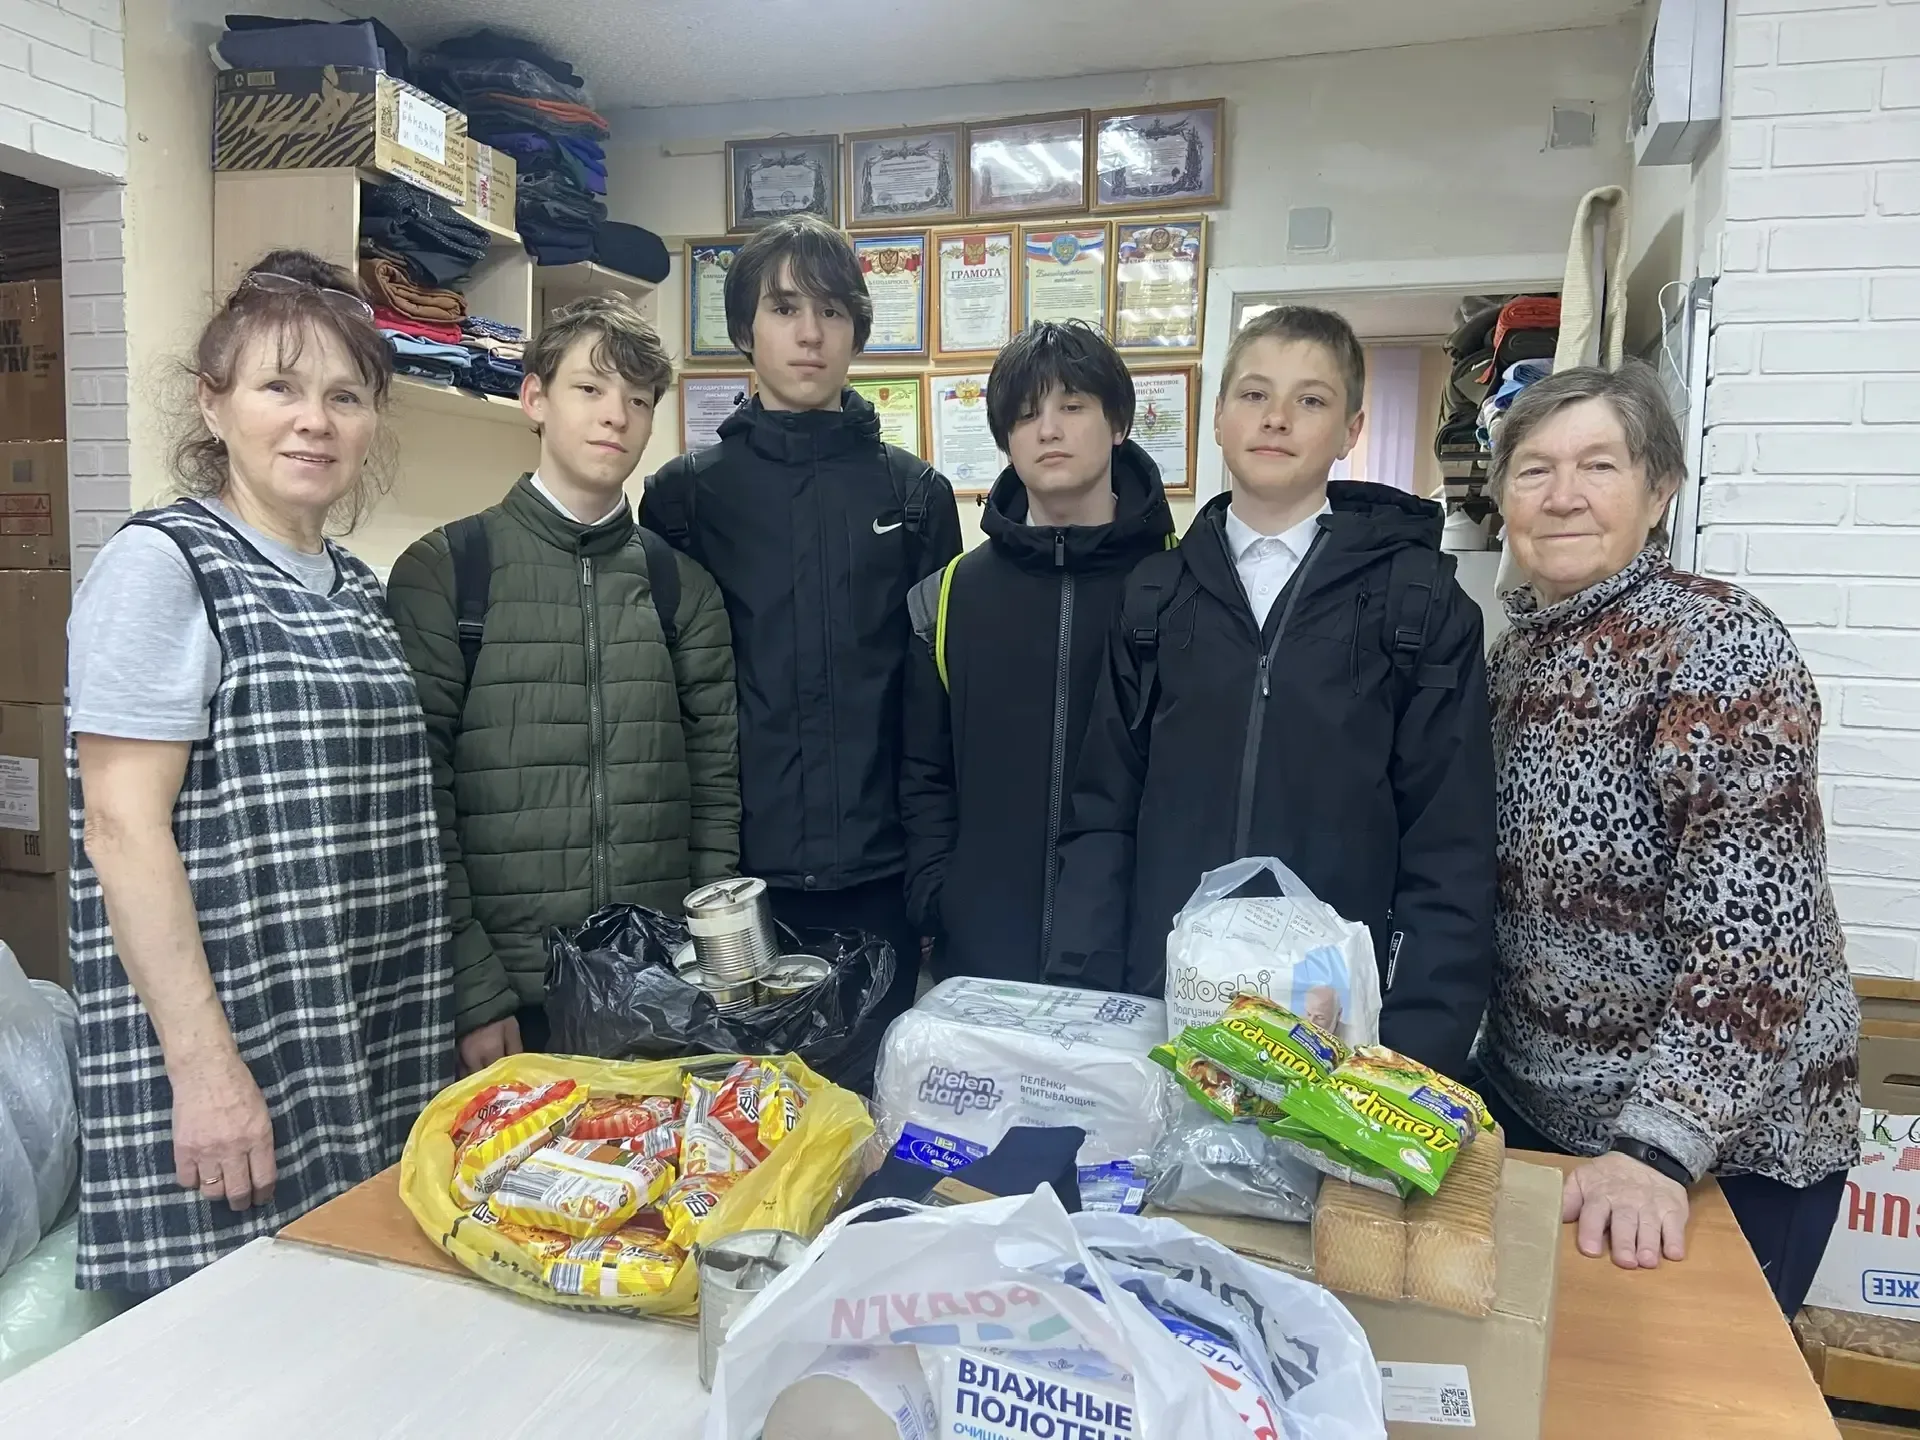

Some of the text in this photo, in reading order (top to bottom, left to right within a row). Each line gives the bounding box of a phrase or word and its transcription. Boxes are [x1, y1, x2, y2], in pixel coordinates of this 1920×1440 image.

[950, 267, 1001, 280] ГРАМОТА
[1173, 966, 1272, 1003] kioshi
[1173, 1002, 1224, 1018] Подгузник
[929, 1065, 995, 1093] Helen
[1020, 1074, 1067, 1092] ПЕЛЁНКИ
[918, 1079, 1002, 1116] Harper
[1020, 1084, 1097, 1108] ВПИТЫВАЮЩИЕ
[958, 1357, 1133, 1432] ВЛАЖНЫЕ
[956, 1387, 1133, 1440] ПОЛОТЕ
